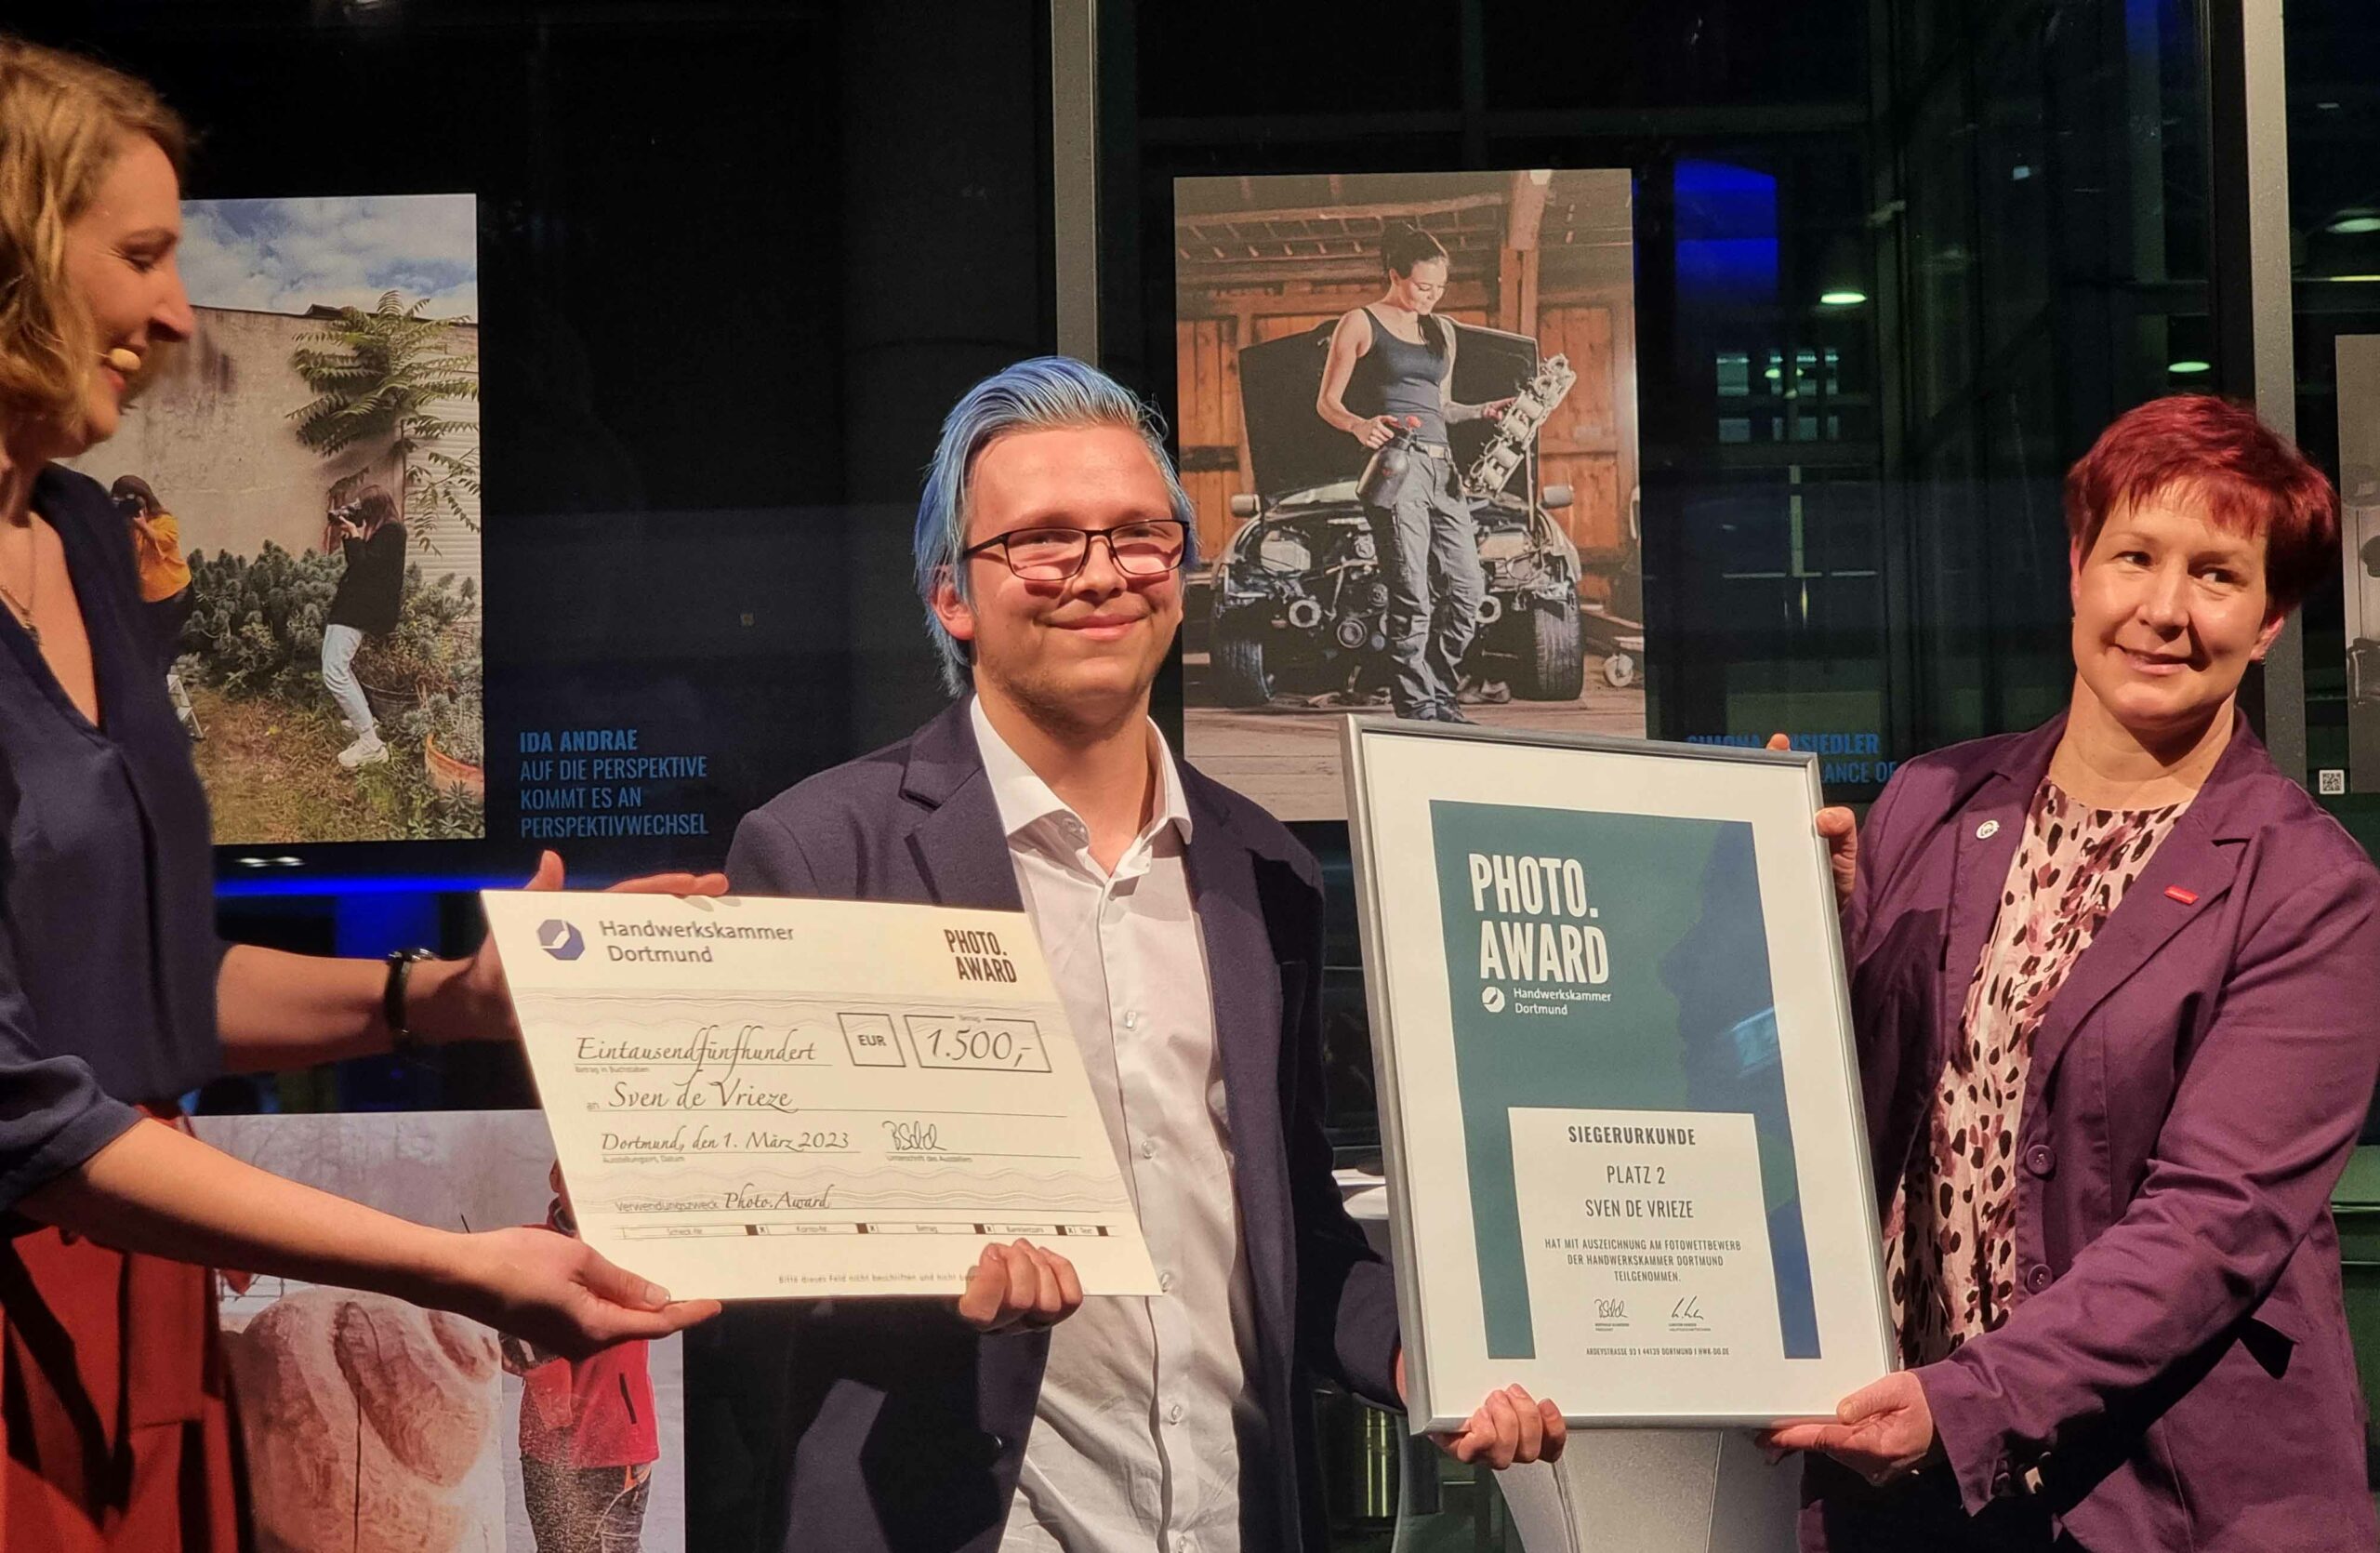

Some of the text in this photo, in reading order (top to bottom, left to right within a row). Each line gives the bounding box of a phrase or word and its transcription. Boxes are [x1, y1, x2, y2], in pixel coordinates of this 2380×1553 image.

[520, 729, 637, 752] IDA ANDRAE
[520, 756, 707, 781] AUF DIE PERSPEKTIVE
[1823, 762, 1871, 782] ANCE
[521, 787, 641, 809] KOMMT ES AN
[521, 814, 708, 838] PERSPEKTIVWECHSEL
[1469, 854, 1598, 918] PHOTO.
[599, 920, 793, 940] Handwerkskammer
[944, 929, 1007, 956] PHOTO.
[1480, 921, 1608, 984] AWARD
[607, 945, 713, 962] Dortmund
[956, 956, 1017, 983] AWARD
[1514, 988, 1611, 1002] Handwerkskammer
[1515, 1002, 1567, 1015] Dortmund
[858, 1034, 886, 1047] EUR
[928, 1029, 1032, 1067] 1.500,-
[576, 1025, 815, 1081] Eintausendfünfhundert
[609, 1070, 798, 1113] Sven de Vrieze
[602, 1125, 849, 1152] Dortmund, den 1. März 2023
[1567, 1125, 1696, 1145] SIEGERURKUNDE
[1606, 1165, 1666, 1184] PLATZ 2
[615, 1200, 719, 1213] Verwendungszweck
[1585, 1200, 1694, 1218] SVEN DE VRIEZE
[1545, 1239, 1741, 1251] HAT MIT AUSZEICHNUNG AM FOTOWETTBEWERB
[1567, 1254, 1724, 1267] DER HANDWERKSKAMMER DORTMUND
[1614, 1270, 1681, 1282] TEILGENOMMEN.
[1661, 1347, 1693, 1356] DORTMUND
